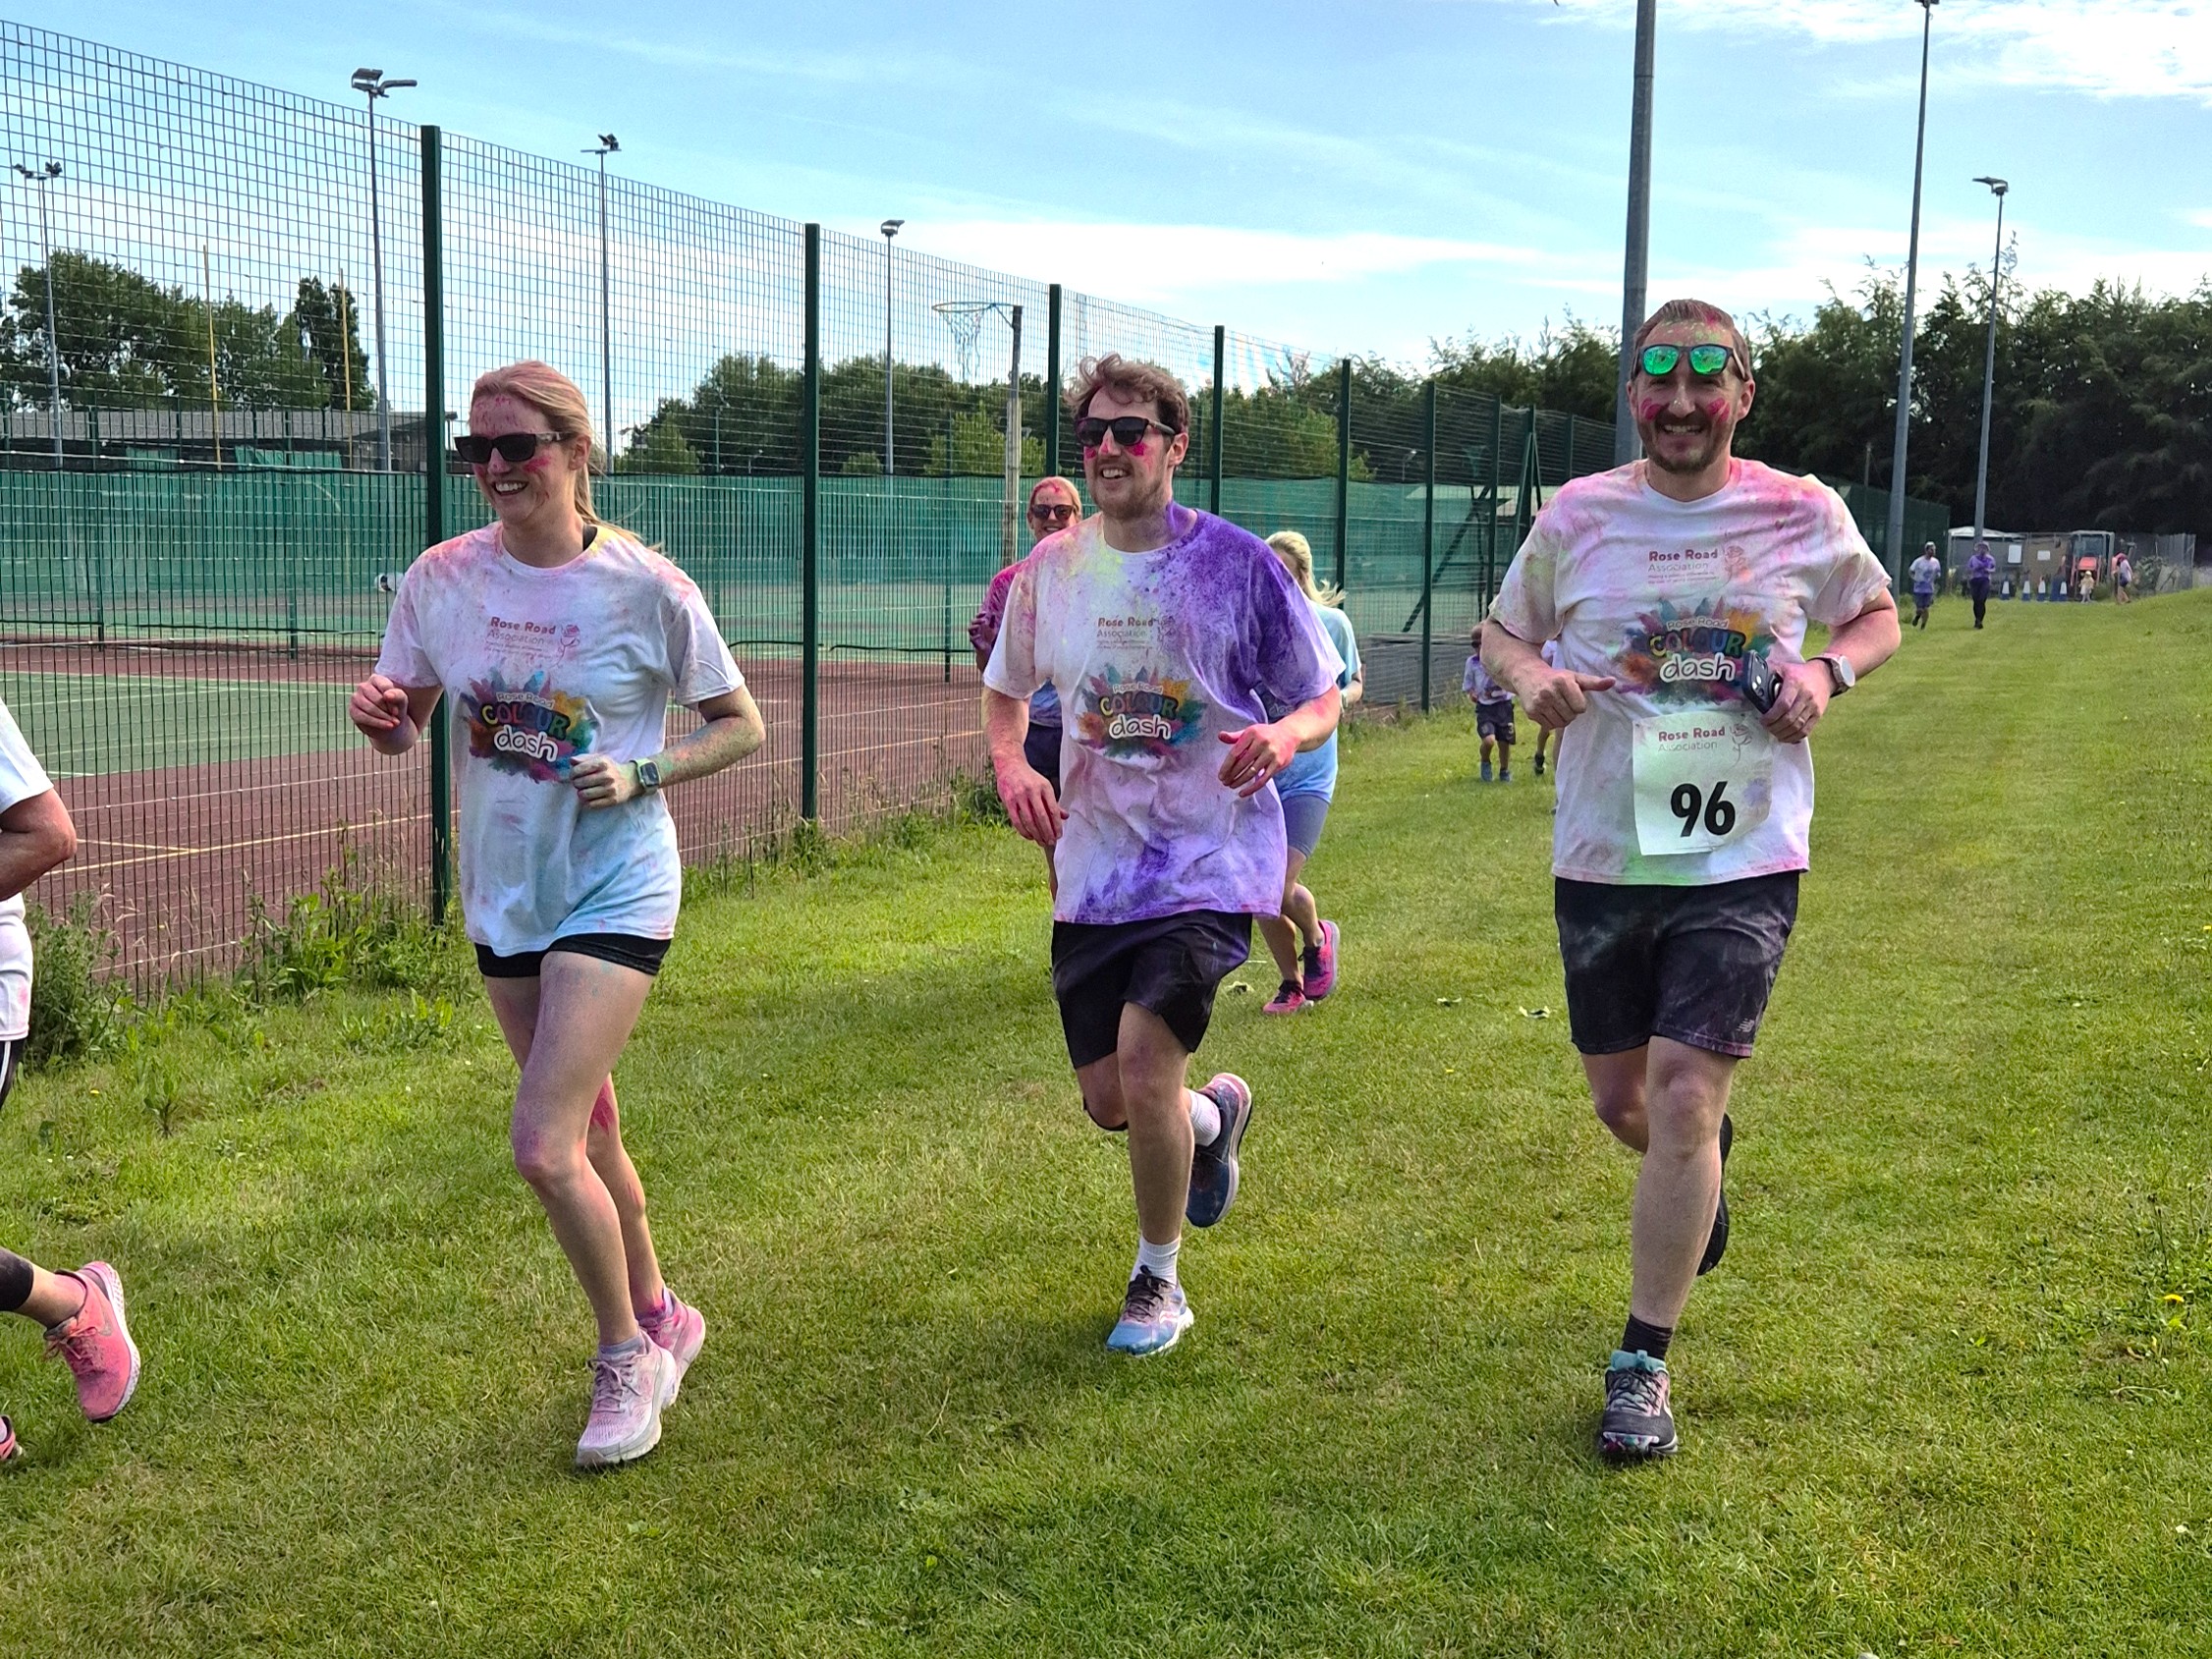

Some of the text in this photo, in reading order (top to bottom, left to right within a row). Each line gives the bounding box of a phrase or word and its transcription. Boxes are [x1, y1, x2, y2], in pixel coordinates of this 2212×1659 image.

[1649, 548, 1718, 562] Rose Road
[490, 616, 557, 636] Rose Road
[1097, 617, 1124, 628] Rose
[1667, 616, 1730, 631] Rose Road
[1649, 628, 1746, 657] COLOUR
[1660, 652, 1736, 683] dash
[496, 691, 524, 703] Rose
[1099, 691, 1178, 719] COLOUR
[481, 703, 570, 741] COLOUR
[1108, 713, 1172, 741] dash
[1658, 726, 1726, 743] Rose Road
[494, 724, 558, 762] dash
[1670, 780, 1737, 838] 96
